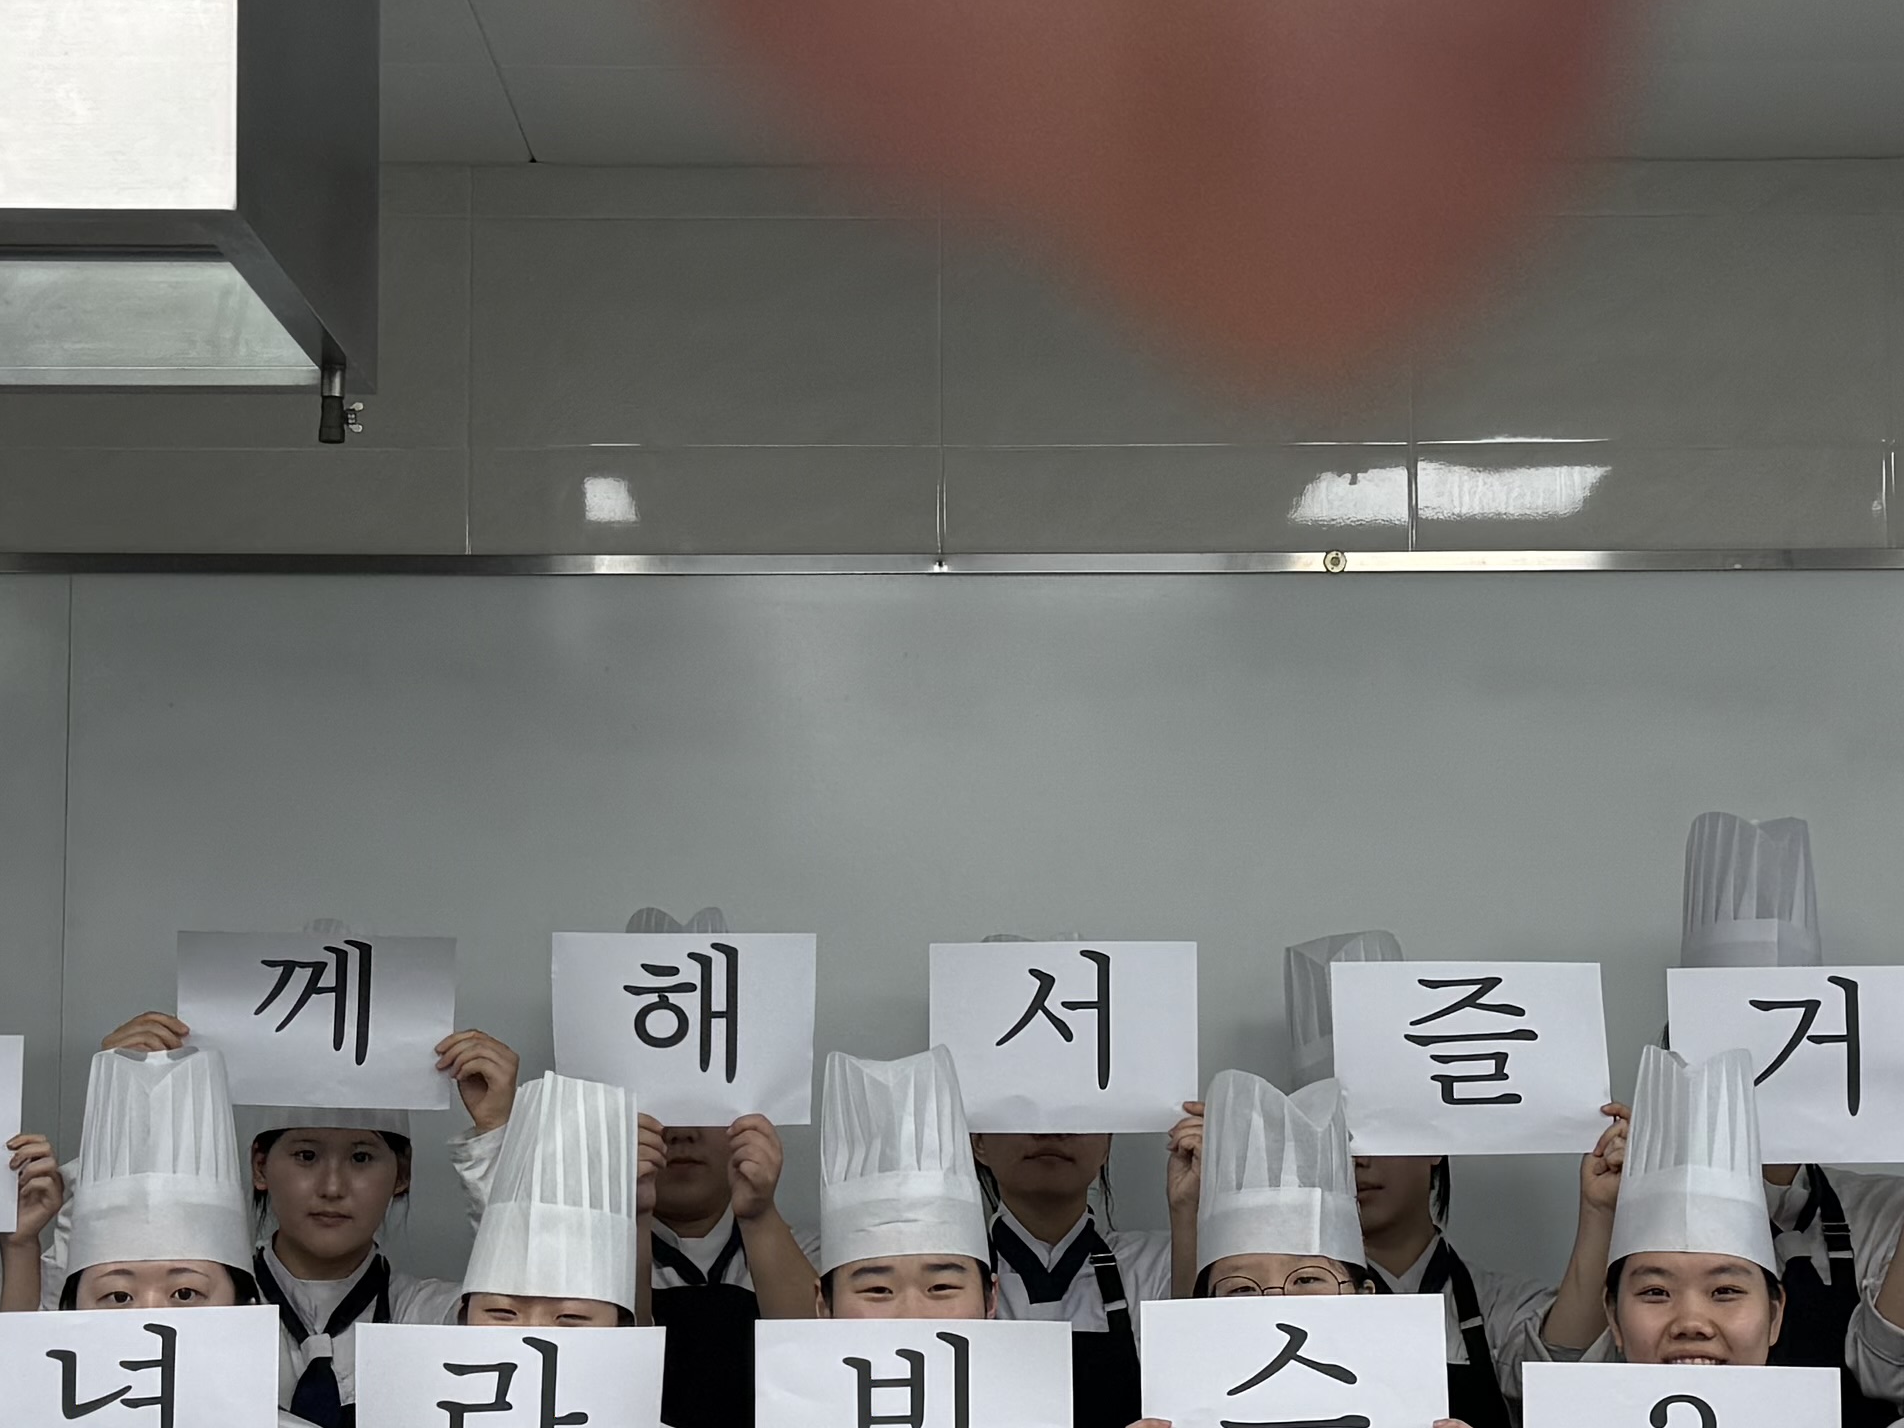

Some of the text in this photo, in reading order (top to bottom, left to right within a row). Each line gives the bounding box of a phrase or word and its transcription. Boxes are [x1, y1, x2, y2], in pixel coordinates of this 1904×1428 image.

[254, 940, 372, 1065] 께
[623, 943, 738, 1086] 해
[996, 950, 1110, 1090] 서
[1404, 977, 1538, 1105] 즐
[1749, 976, 1860, 1116] 거
